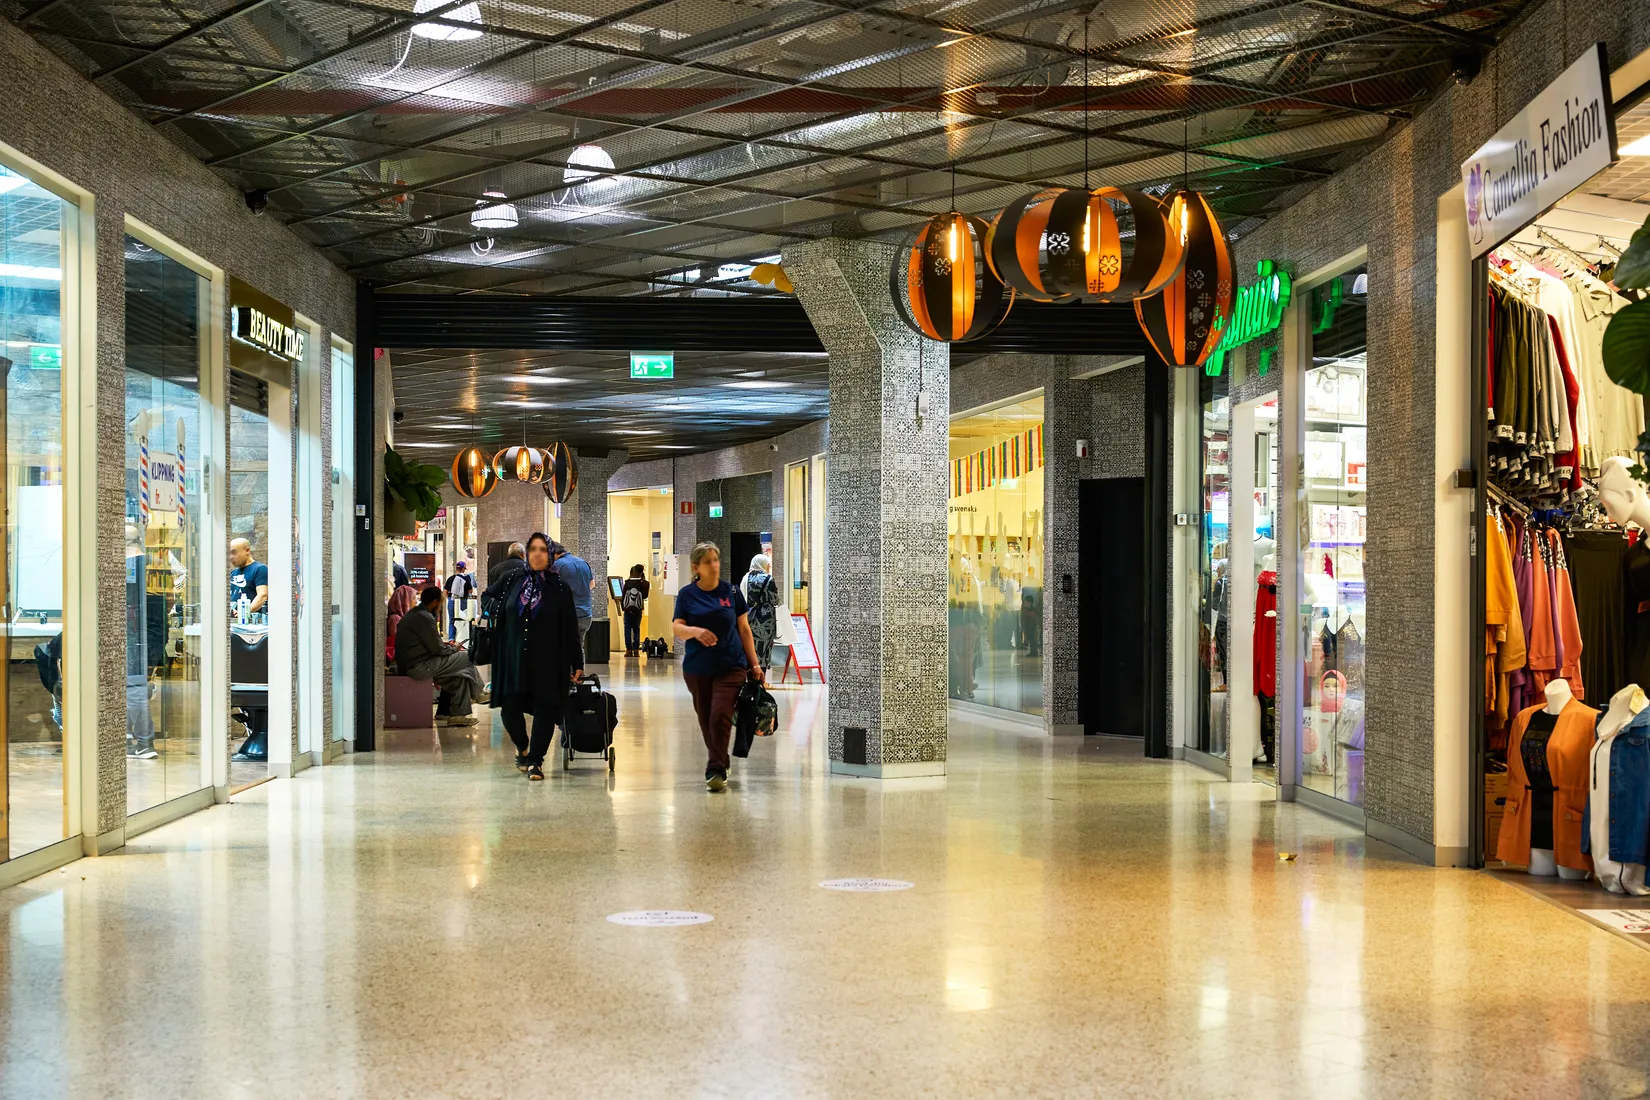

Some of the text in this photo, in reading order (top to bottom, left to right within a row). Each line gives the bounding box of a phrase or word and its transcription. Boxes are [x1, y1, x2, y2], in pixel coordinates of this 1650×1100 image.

[1482, 96, 1603, 222] Camellia Fashion
[250, 307, 304, 362] BEAUTY TIME
